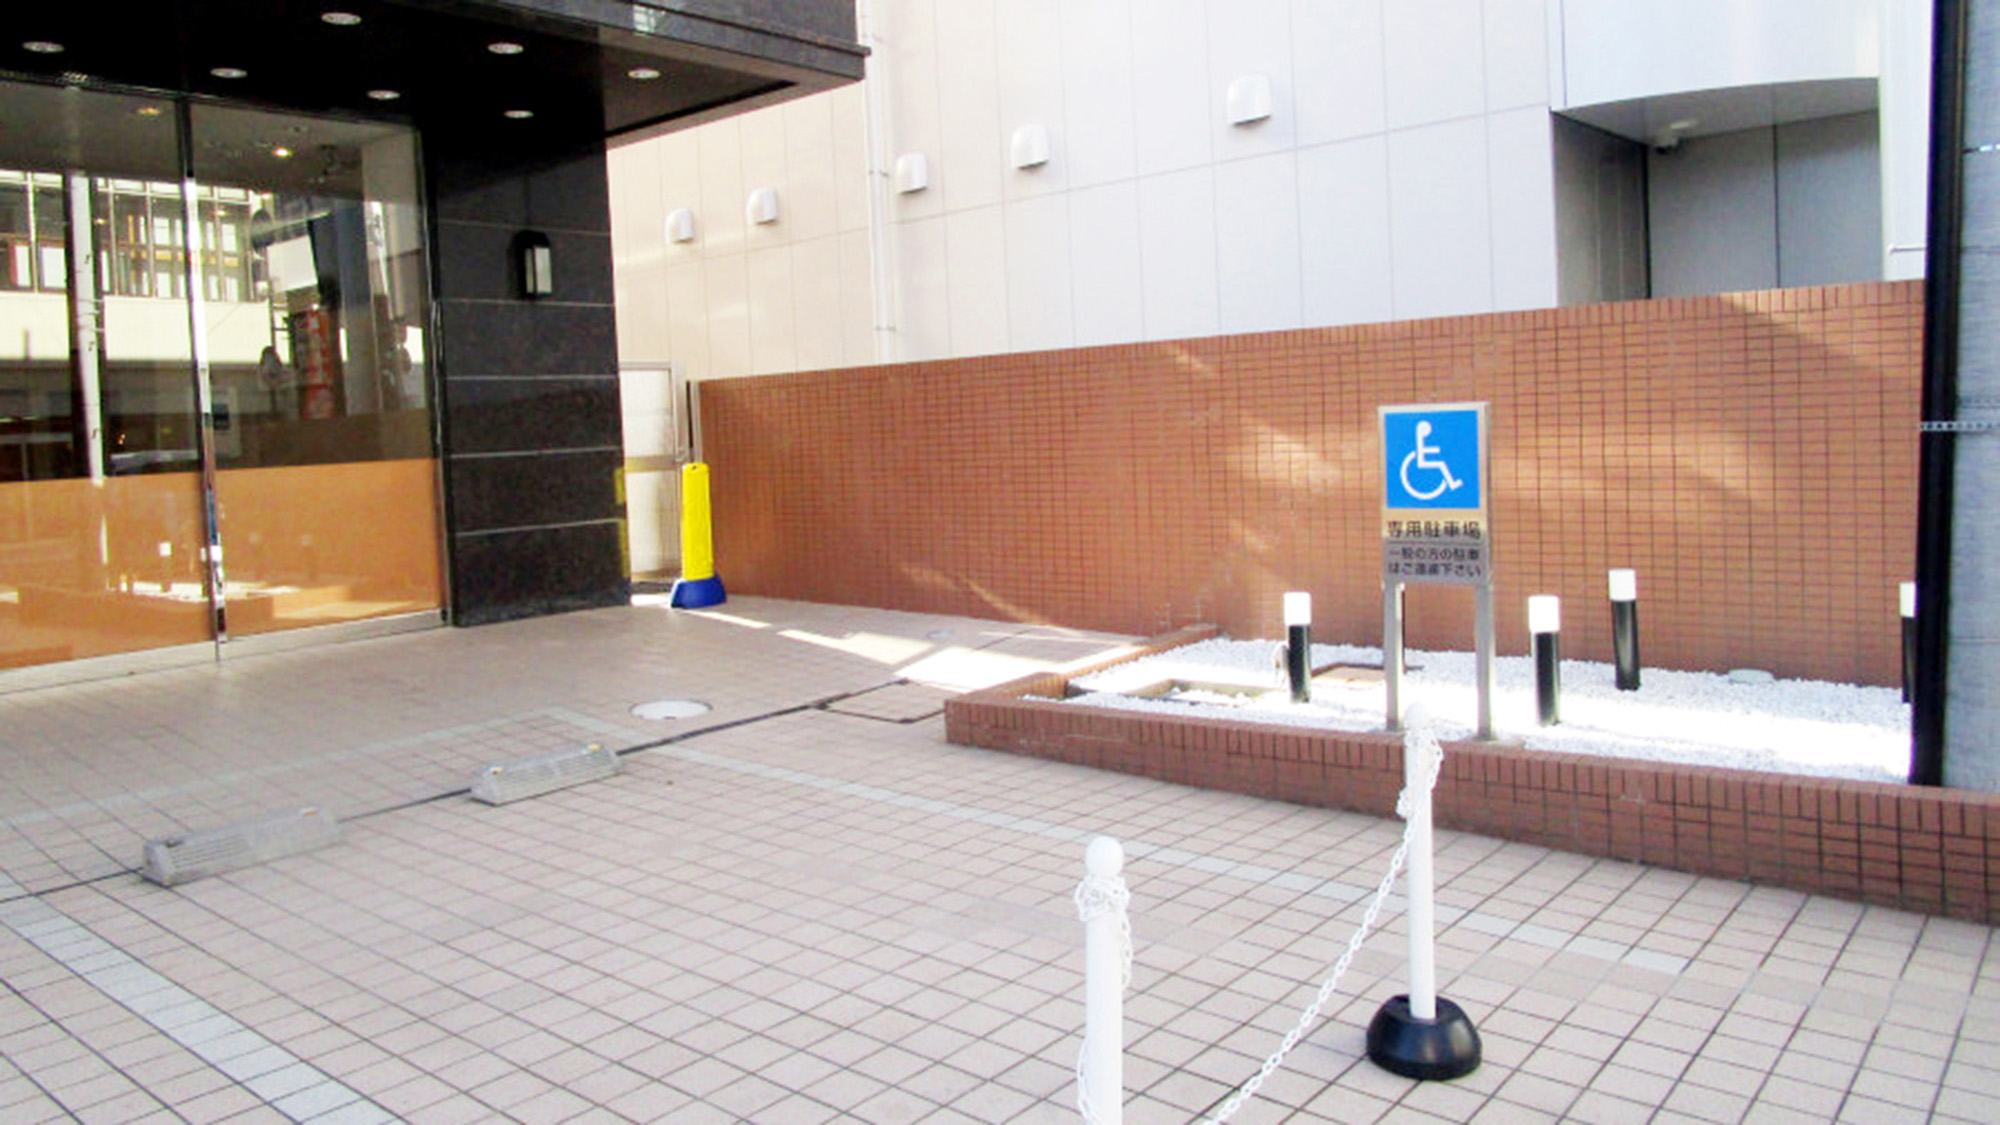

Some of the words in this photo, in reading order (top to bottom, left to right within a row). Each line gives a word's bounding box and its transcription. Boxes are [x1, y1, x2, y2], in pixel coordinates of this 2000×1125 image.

[1387, 520, 1481, 539] 専用駐車場
[1388, 547, 1479, 561] 一般の方の駐車
